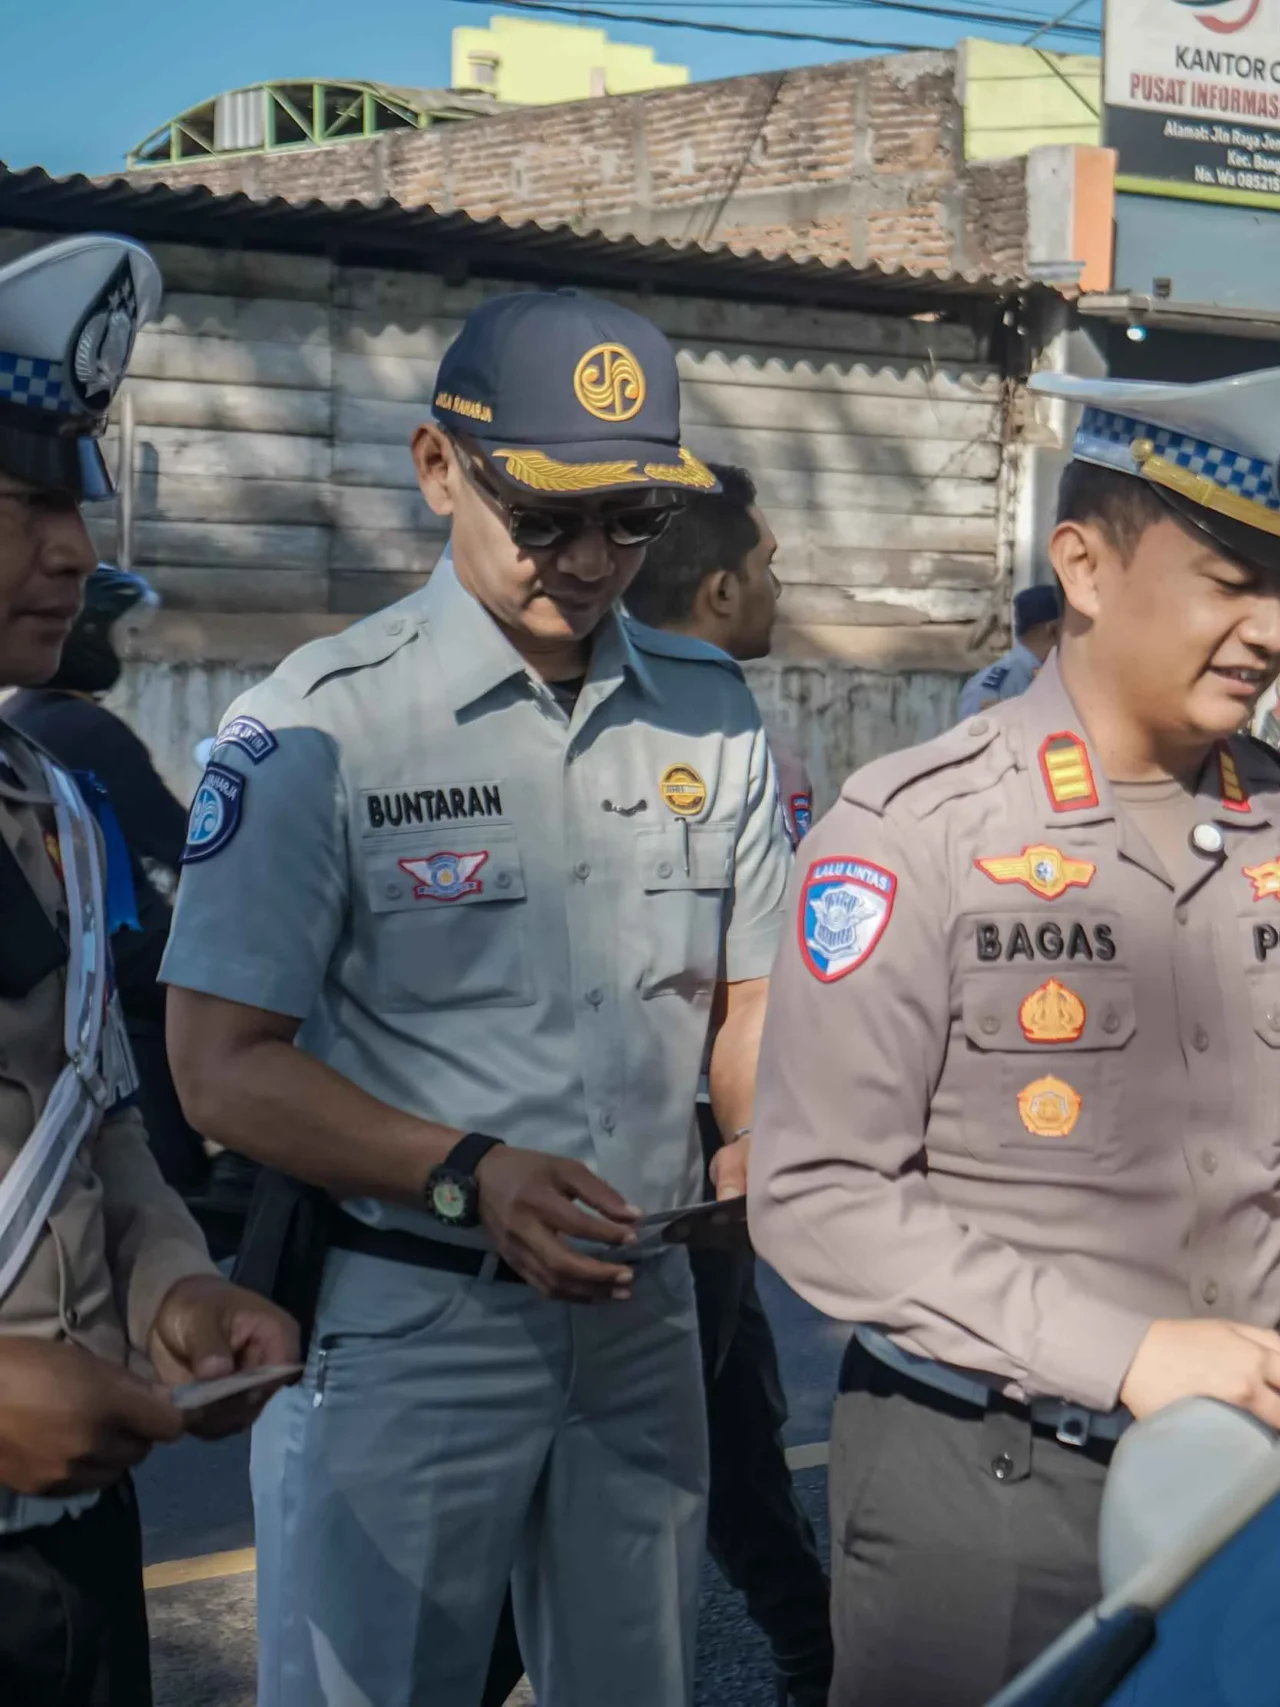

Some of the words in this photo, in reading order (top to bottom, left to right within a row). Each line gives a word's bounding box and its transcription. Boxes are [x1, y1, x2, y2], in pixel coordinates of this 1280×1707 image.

[1175, 45, 1265, 81] KANTOR
[1130, 72, 1186, 105] PUSAT
[1163, 119, 1209, 141] Alamat:
[1211, 125, 1230, 144] Jln
[1232, 128, 1260, 151] Raya
[1227, 148, 1251, 167] Kec.
[1194, 165, 1215, 183] No.
[1216, 167, 1235, 186] Wa
[367, 785, 502, 828] BUNTARAN
[814, 862, 845, 879] LALU
[846, 862, 889, 892] LINTAS
[976, 922, 1116, 961] BAGAS
